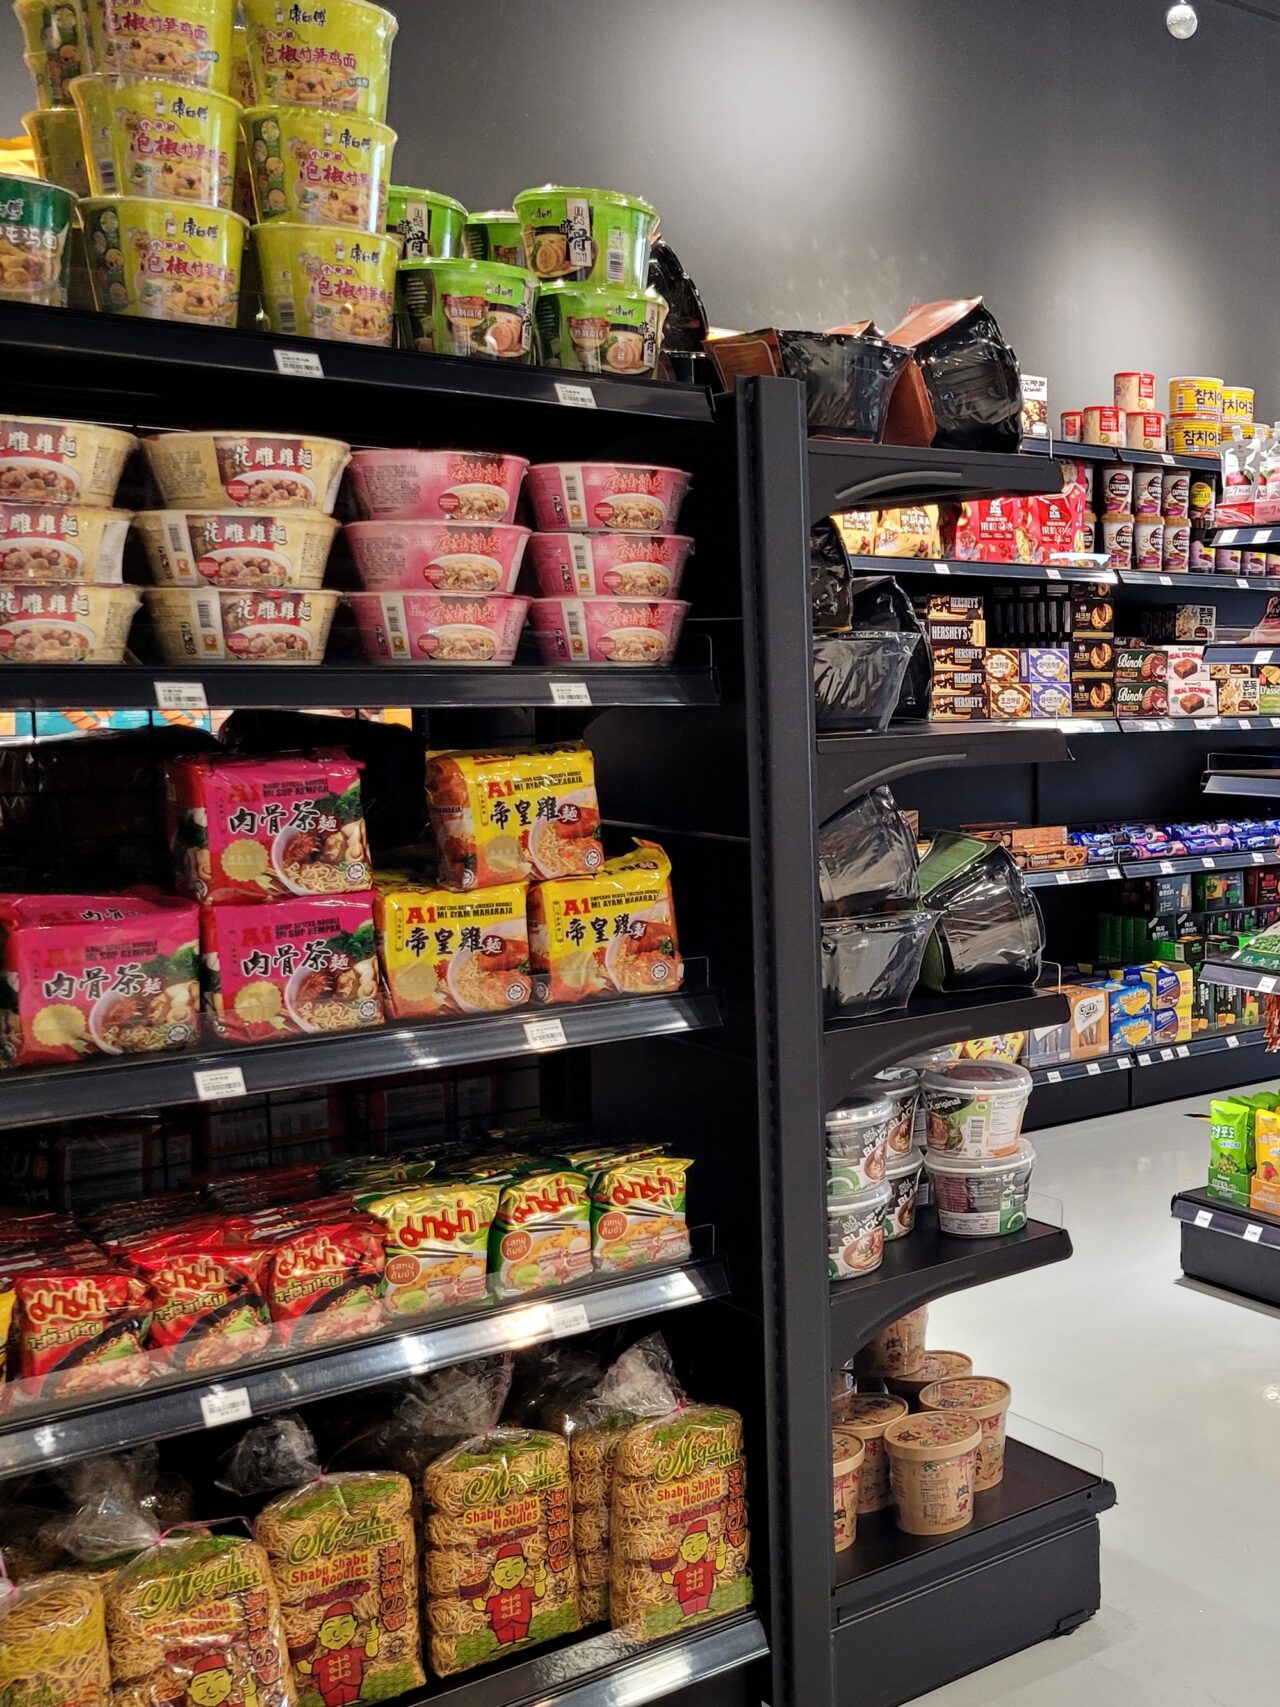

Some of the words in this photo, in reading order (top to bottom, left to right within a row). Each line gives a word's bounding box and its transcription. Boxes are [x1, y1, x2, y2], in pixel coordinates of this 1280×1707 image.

[950, 596, 979, 609] HERSHEY'S
[931, 625, 969, 640] HERSHEY'S
[954, 647, 983, 660] HERSHEY'S
[1117, 653, 1143, 668] Binch
[954, 671, 983, 684] HERSHEY'S
[954, 696, 983, 709] HERSHEY'S
[1117, 687, 1143, 701] Binch
[487, 779, 515, 799] A1
[437, 911, 448, 919] MI
[450, 909, 471, 919] AYAM
[473, 907, 513, 917] MAHARAJA
[563, 897, 592, 917] A1
[603, 899, 623, 908] AYAM
[406, 905, 438, 925] A1
[288, 929, 307, 938] SUP
[405, 925, 504, 958] 帝皇雞麵
[242, 939, 352, 978] 肉骨茶麵
[43, 962, 162, 1001] 肉骨茶麵
[841, 1217, 880, 1247] BLACK
[654, 1428, 728, 1483] Megah
[536, 1471, 563, 1490] MEE
[656, 1486, 689, 1502] Shabu
[691, 1476, 721, 1493] Shabu
[682, 1487, 721, 1507] Noodles
[465, 1508, 501, 1525] Shabu
[504, 1499, 537, 1516] Shabu
[493, 1510, 538, 1530] Noodles
[289, 1503, 381, 1564] Megah
[367, 1524, 401, 1545] MEE
[291, 1564, 329, 1584] Shabu
[332, 1552, 369, 1572] Shabu
[321, 1564, 369, 1588] Noodles
[138, 1547, 244, 1618] Megah
[228, 1570, 262, 1593] MEE
